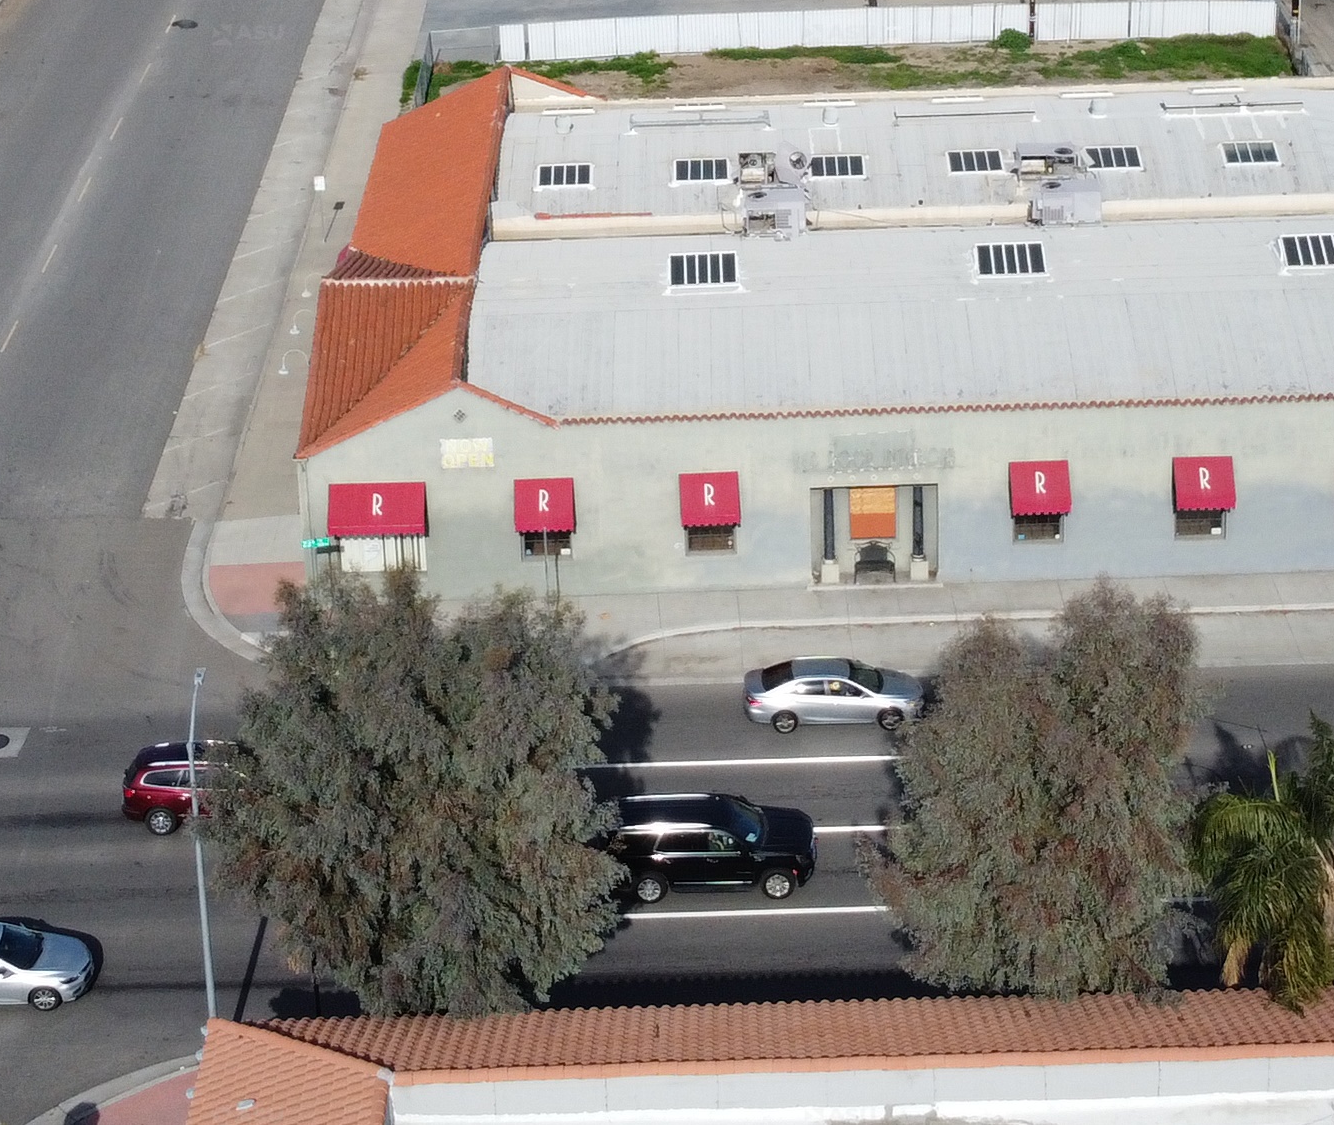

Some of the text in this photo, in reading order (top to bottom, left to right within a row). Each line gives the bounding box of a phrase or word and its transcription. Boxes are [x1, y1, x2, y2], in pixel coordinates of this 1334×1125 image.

[444, 438, 489, 453] NOW
[442, 453, 495, 469] OPEN
[1034, 470, 1047, 495] R
[1198, 466, 1212, 490] R
[371, 492, 383, 516] R
[538, 488, 550, 513] R
[703, 482, 716, 507] R
